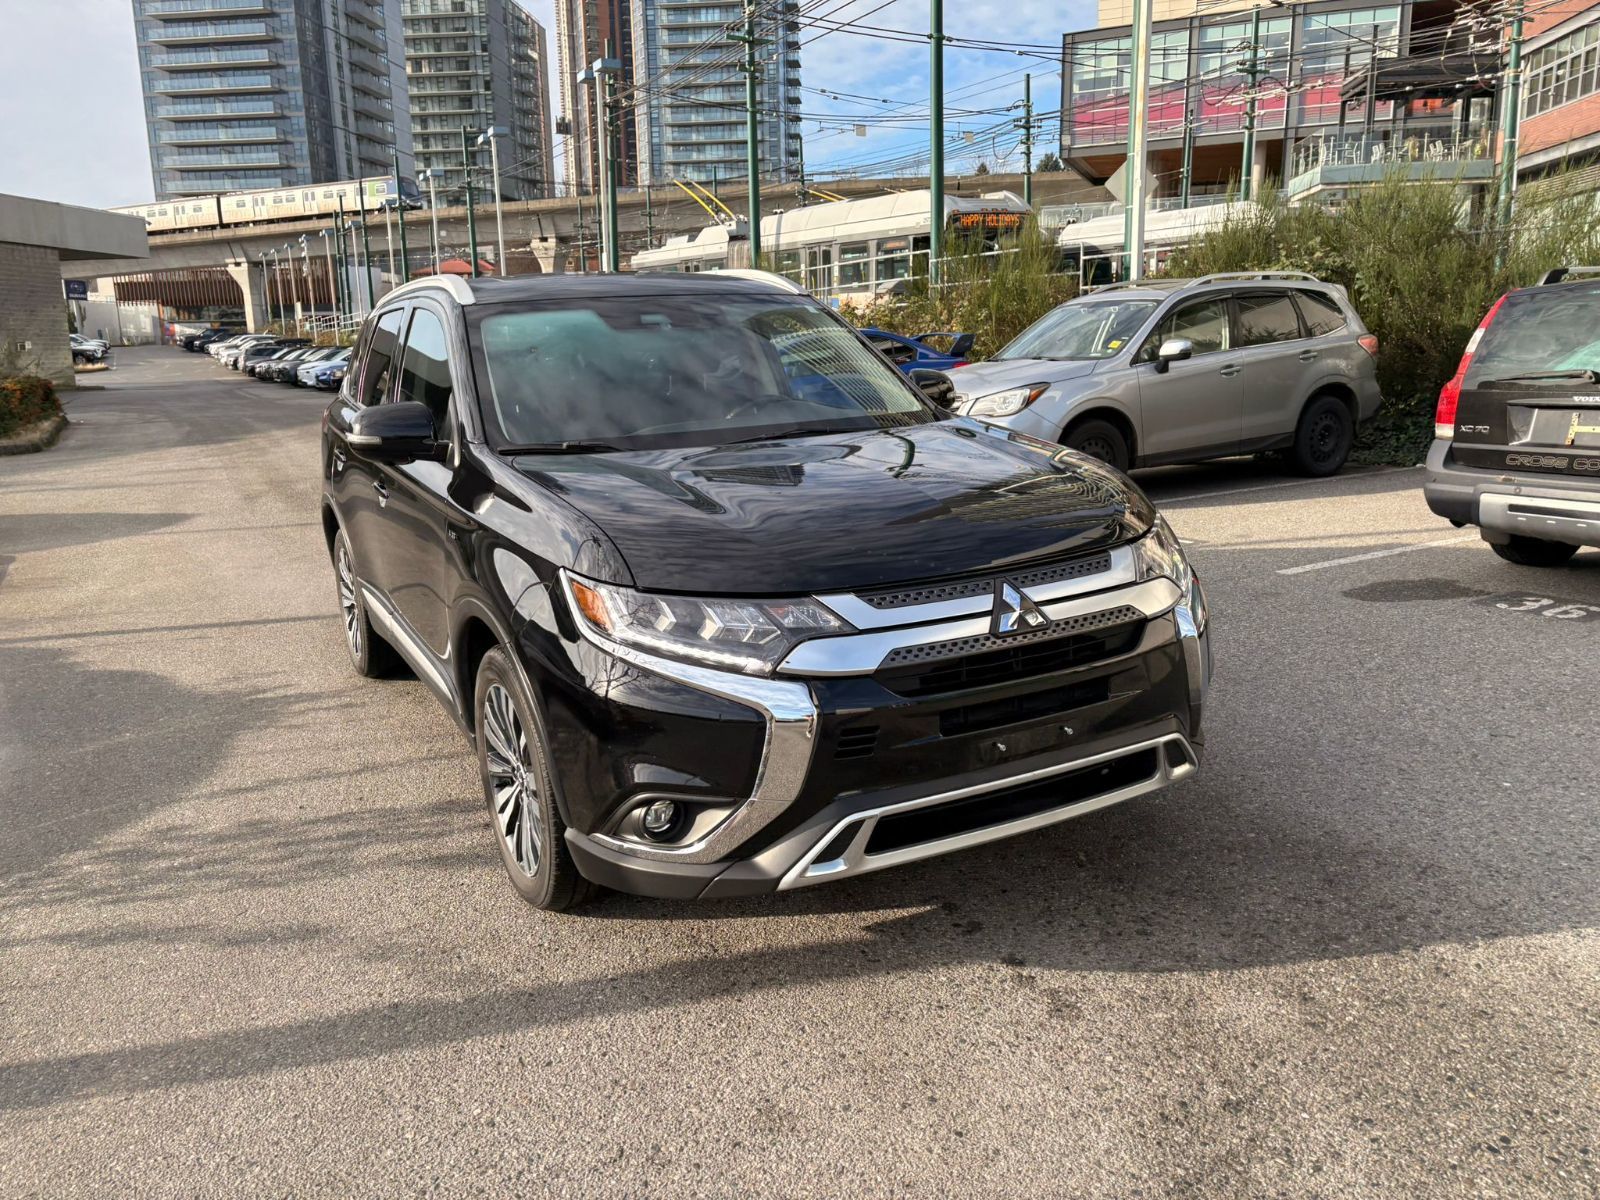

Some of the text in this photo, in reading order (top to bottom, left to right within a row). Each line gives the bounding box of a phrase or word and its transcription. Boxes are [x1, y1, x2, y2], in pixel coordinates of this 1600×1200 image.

[960, 213, 1020, 226] HAPPY HOLIDAYS
[1505, 453, 1569, 469] CROSS
